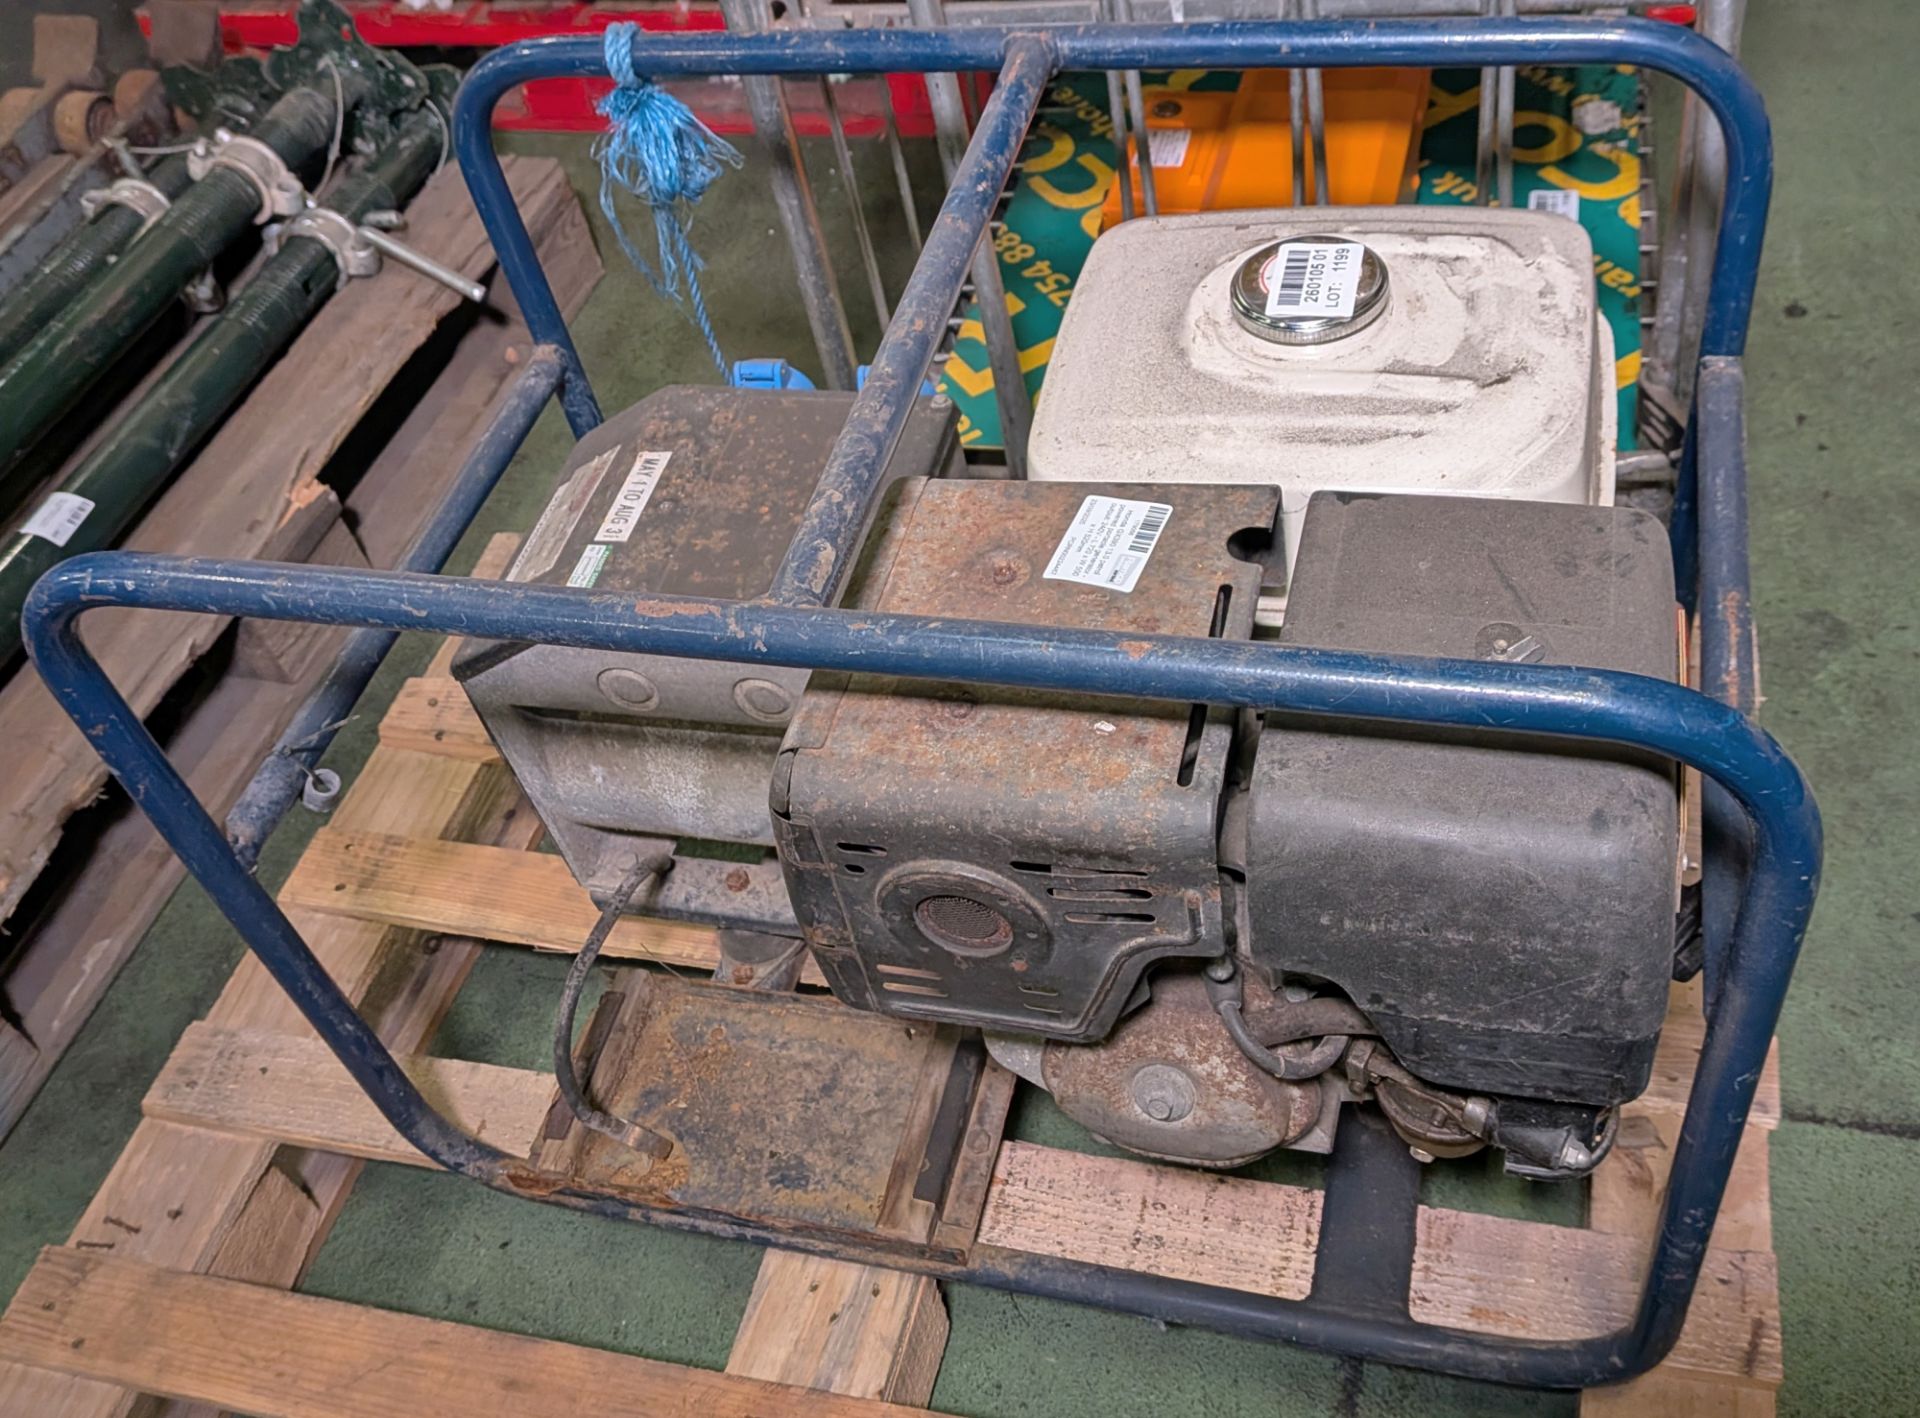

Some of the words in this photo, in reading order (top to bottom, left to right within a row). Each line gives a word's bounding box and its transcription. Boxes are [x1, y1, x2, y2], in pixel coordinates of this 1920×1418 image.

[1332, 248, 1350, 273] 1199
[1021, 260, 1073, 310] 754
[1304, 262, 1326, 303] 260105
[1325, 282, 1343, 308] LOT:
[635, 457, 660, 477] MAY
[623, 487, 645, 501] TO
[610, 503, 636, 525] AUG
